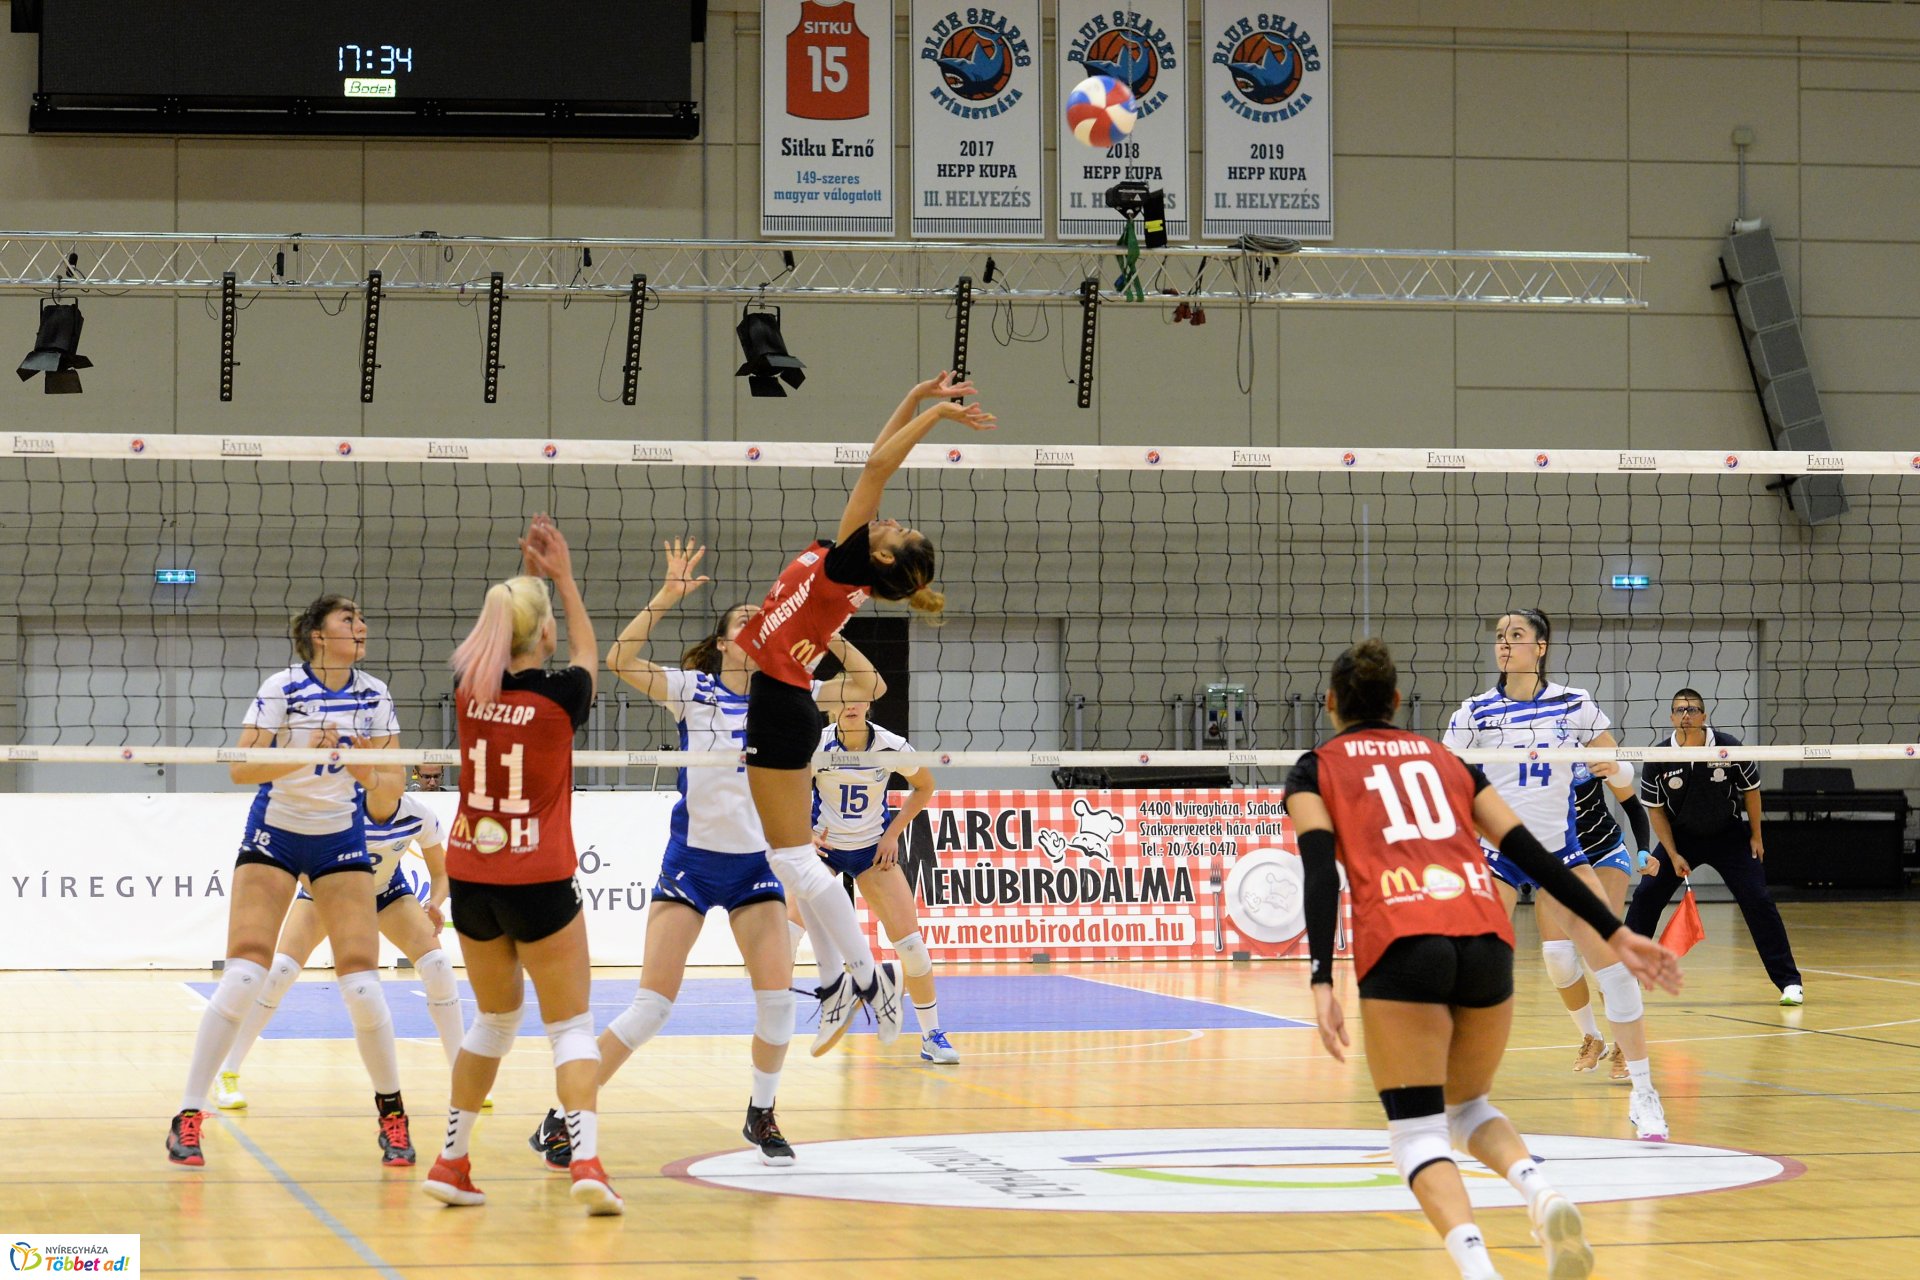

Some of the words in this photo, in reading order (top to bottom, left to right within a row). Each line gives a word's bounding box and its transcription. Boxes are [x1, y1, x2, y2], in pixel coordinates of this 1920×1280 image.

[804, 22, 852, 34] SITKU
[922, 12, 962, 60] BLUE
[966, 8, 1031, 67] SHARKS
[1067, 15, 1109, 61] BLUE
[1113, 10, 1176, 69] SHARKS
[1213, 17, 1253, 64] BLUE
[1258, 13, 1320, 72] SHARKS
[338, 44, 412, 74] 17:34
[807, 46, 849, 93] 15
[348, 81, 392, 94] Bodet
[930, 86, 1023, 119] NYÍREGYHÁZA
[1221, 90, 1312, 123] NYÍREGYHÁZA
[781, 137, 826, 157] Sitku
[831, 138, 875, 157] Ernő
[960, 140, 994, 157] 2017
[1106, 142, 1140, 159] 2018
[1250, 143, 1284, 160] 2019
[796, 170, 860, 185] 149-szeres
[937, 164, 975, 178] HEPP
[979, 164, 1018, 178] KUPA
[1083, 165, 1121, 180] HEPP
[1125, 166, 1163, 180] KUPA
[1228, 166, 1266, 180] HEPP
[1269, 167, 1307, 181] KUPA
[774, 190, 820, 204] magyar
[823, 187, 882, 205] válogatott
[924, 190, 943, 207] III.
[946, 185, 1031, 208] HELYEZÉS
[1070, 192, 1087, 209] II.
[1214, 192, 1232, 209] II.
[1236, 188, 1320, 210] HELYEZÉS
[1344, 740, 1431, 758] VICTORIA
[467, 739, 530, 814] 11
[840, 784, 869, 813] 15
[1364, 760, 1456, 845] 10
[1140, 802, 1170, 816] 4400
[1175, 801, 1243, 818] Nyíregyháza,
[1140, 822, 1223, 836] Szakszervezetek
[1226, 821, 1251, 836] háza
[1255, 822, 1281, 836] alatt
[337, 851, 363, 862] Zeus
[1141, 842, 1164, 857] Tel.:
[1167, 841, 1237, 857] 20/561-0472
[753, 881, 779, 890] Zeus
